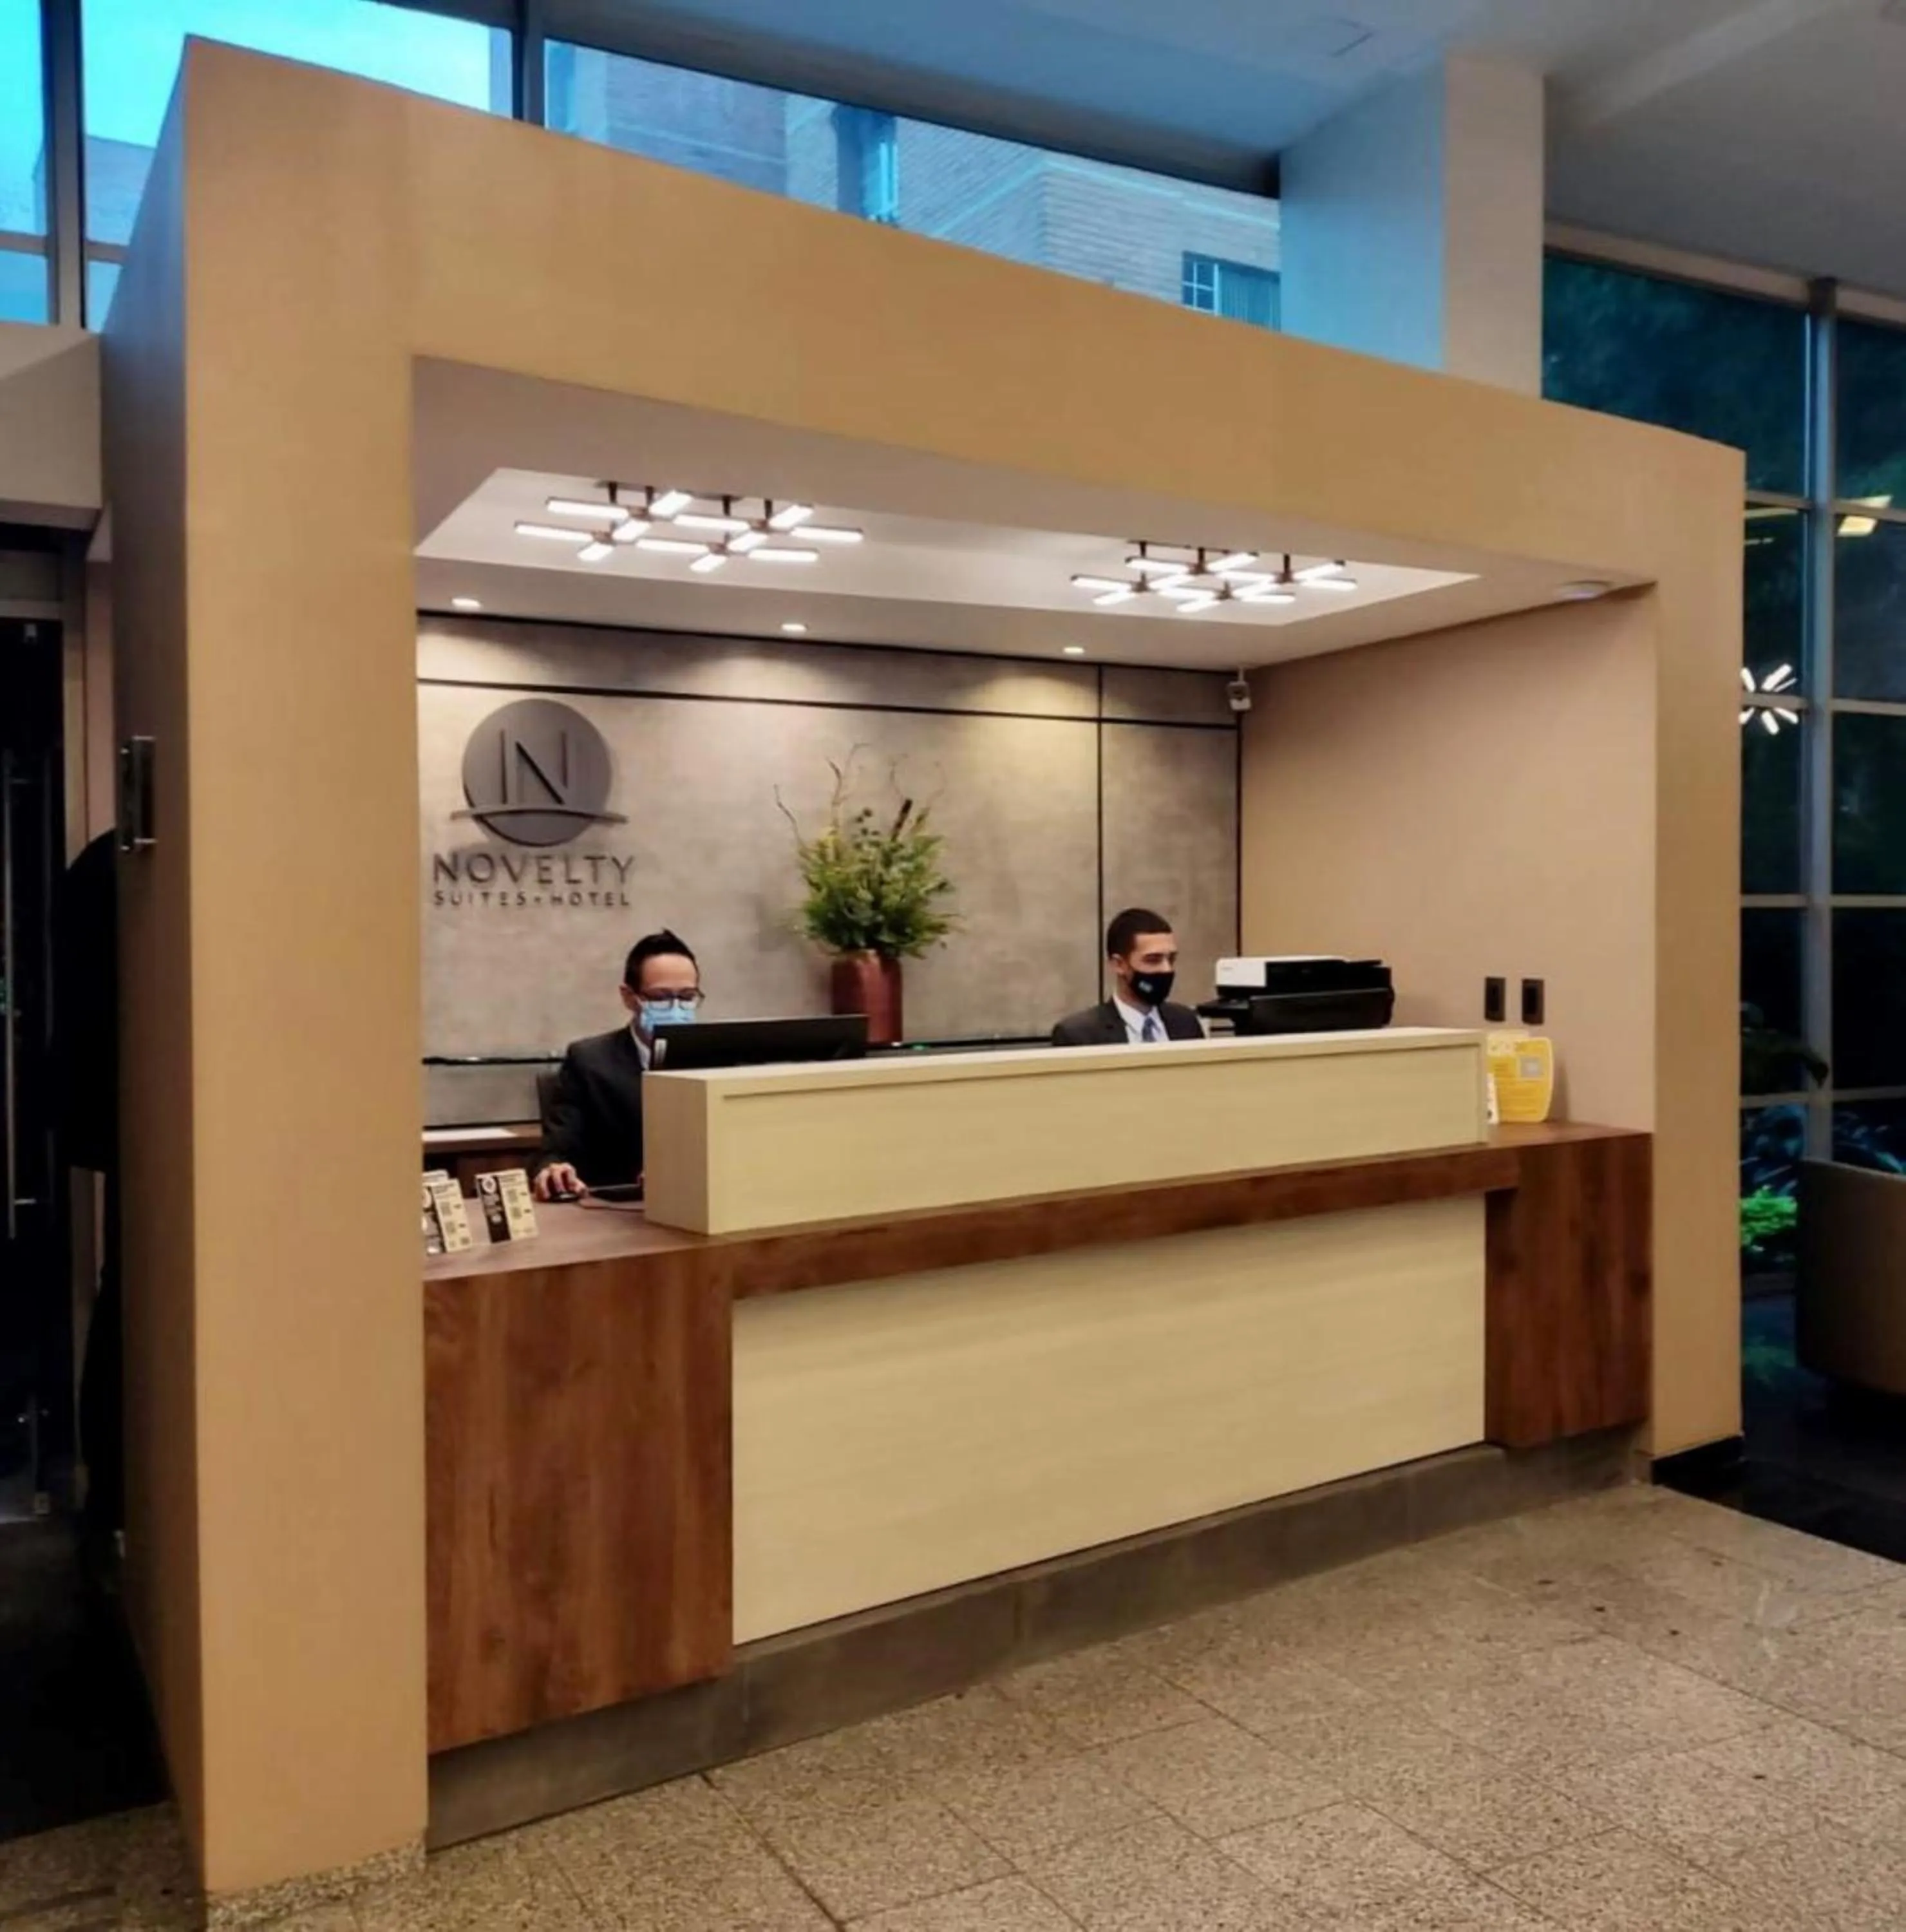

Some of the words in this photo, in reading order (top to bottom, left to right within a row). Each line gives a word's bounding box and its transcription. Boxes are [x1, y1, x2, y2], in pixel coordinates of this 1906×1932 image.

[433, 853, 635, 884] NOVELTY
[433, 891, 526, 906] SUITES
[549, 891, 630, 906] HOTEL
